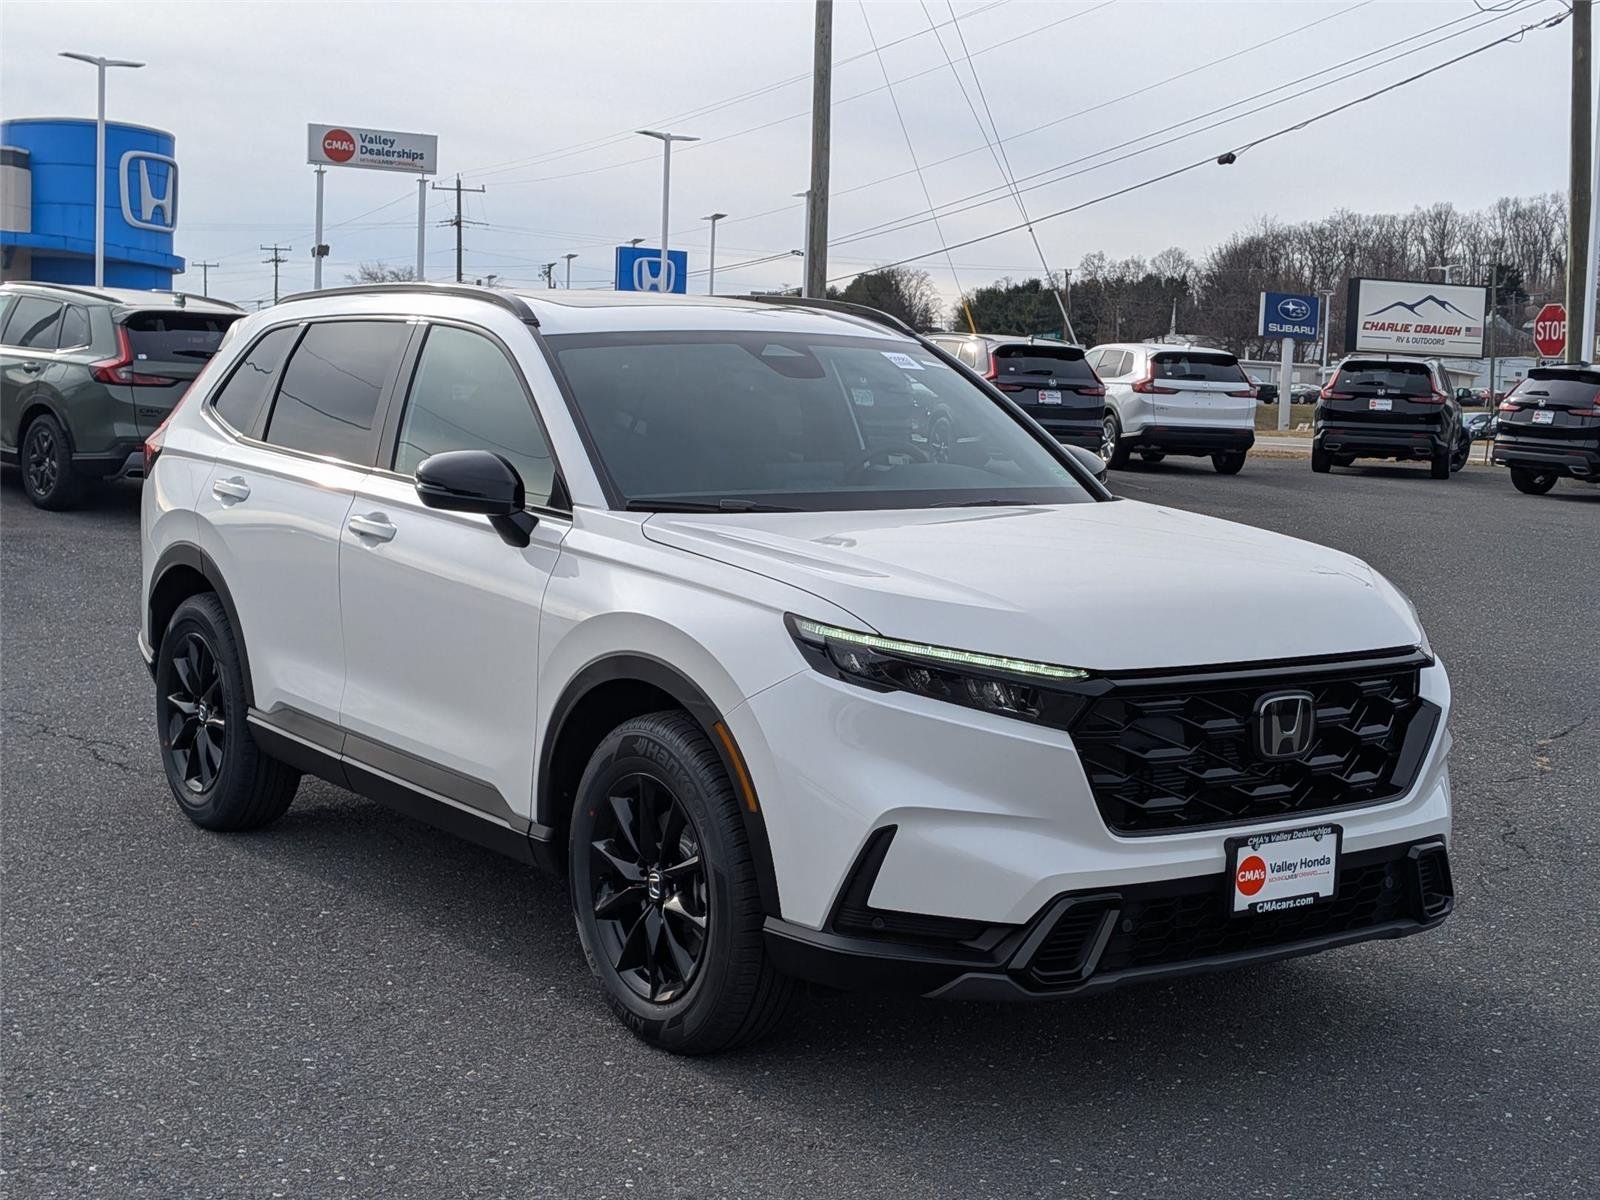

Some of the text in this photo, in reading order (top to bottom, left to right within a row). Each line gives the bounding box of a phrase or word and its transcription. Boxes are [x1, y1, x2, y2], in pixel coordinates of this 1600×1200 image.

[324, 139, 355, 151] CMA's
[359, 133, 396, 148] Valley
[359, 145, 425, 161] Dealerships
[1268, 322, 1316, 336] SUBARU
[1362, 321, 1462, 336] CHARLIE OBAUGH
[1411, 337, 1445, 346] OUTDOORS
[1248, 826, 1332, 846] CMA's Valley Dealerships
[1269, 855, 1331, 874] Valley Honda
[1237, 868, 1265, 882] CMA's
[1256, 896, 1314, 913] CMAcars.com
